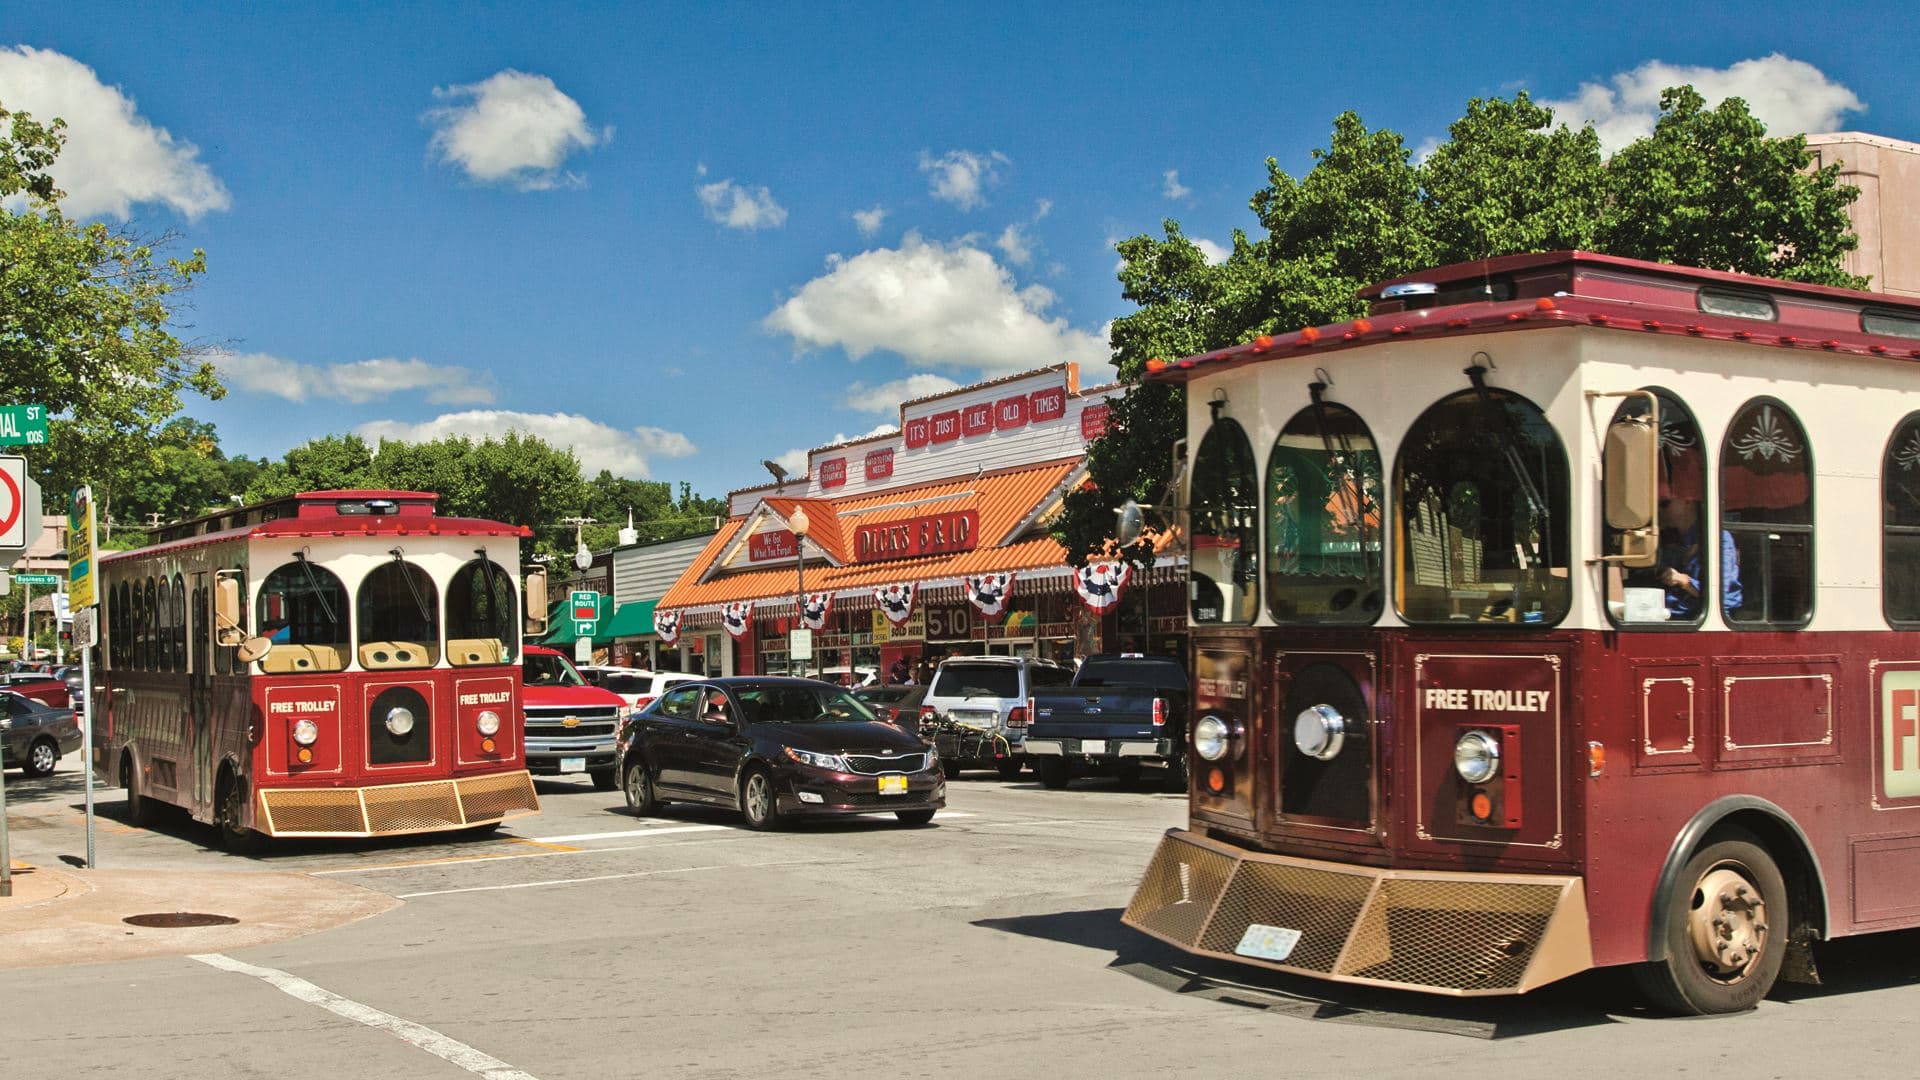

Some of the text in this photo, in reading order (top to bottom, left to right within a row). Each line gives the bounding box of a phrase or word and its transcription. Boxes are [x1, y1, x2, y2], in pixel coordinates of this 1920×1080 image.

[26, 406, 40, 420] ST
[910, 395, 1060, 441] IT'S JUST LIKE OLD TIMES
[26, 430, 44, 444] 100S
[920, 521, 929, 546] 5
[935, 519, 945, 545] &
[950, 516, 969, 544] 10
[763, 532, 781, 545] We Got
[753, 546, 767, 559] What
[891, 627, 907, 637] SOLD
[908, 625, 923, 636] HERE
[459, 691, 511, 705] FREE TROLLEY
[1425, 688, 1550, 712] FREE TROLLEY
[270, 700, 336, 713] FREE TROLLEY
